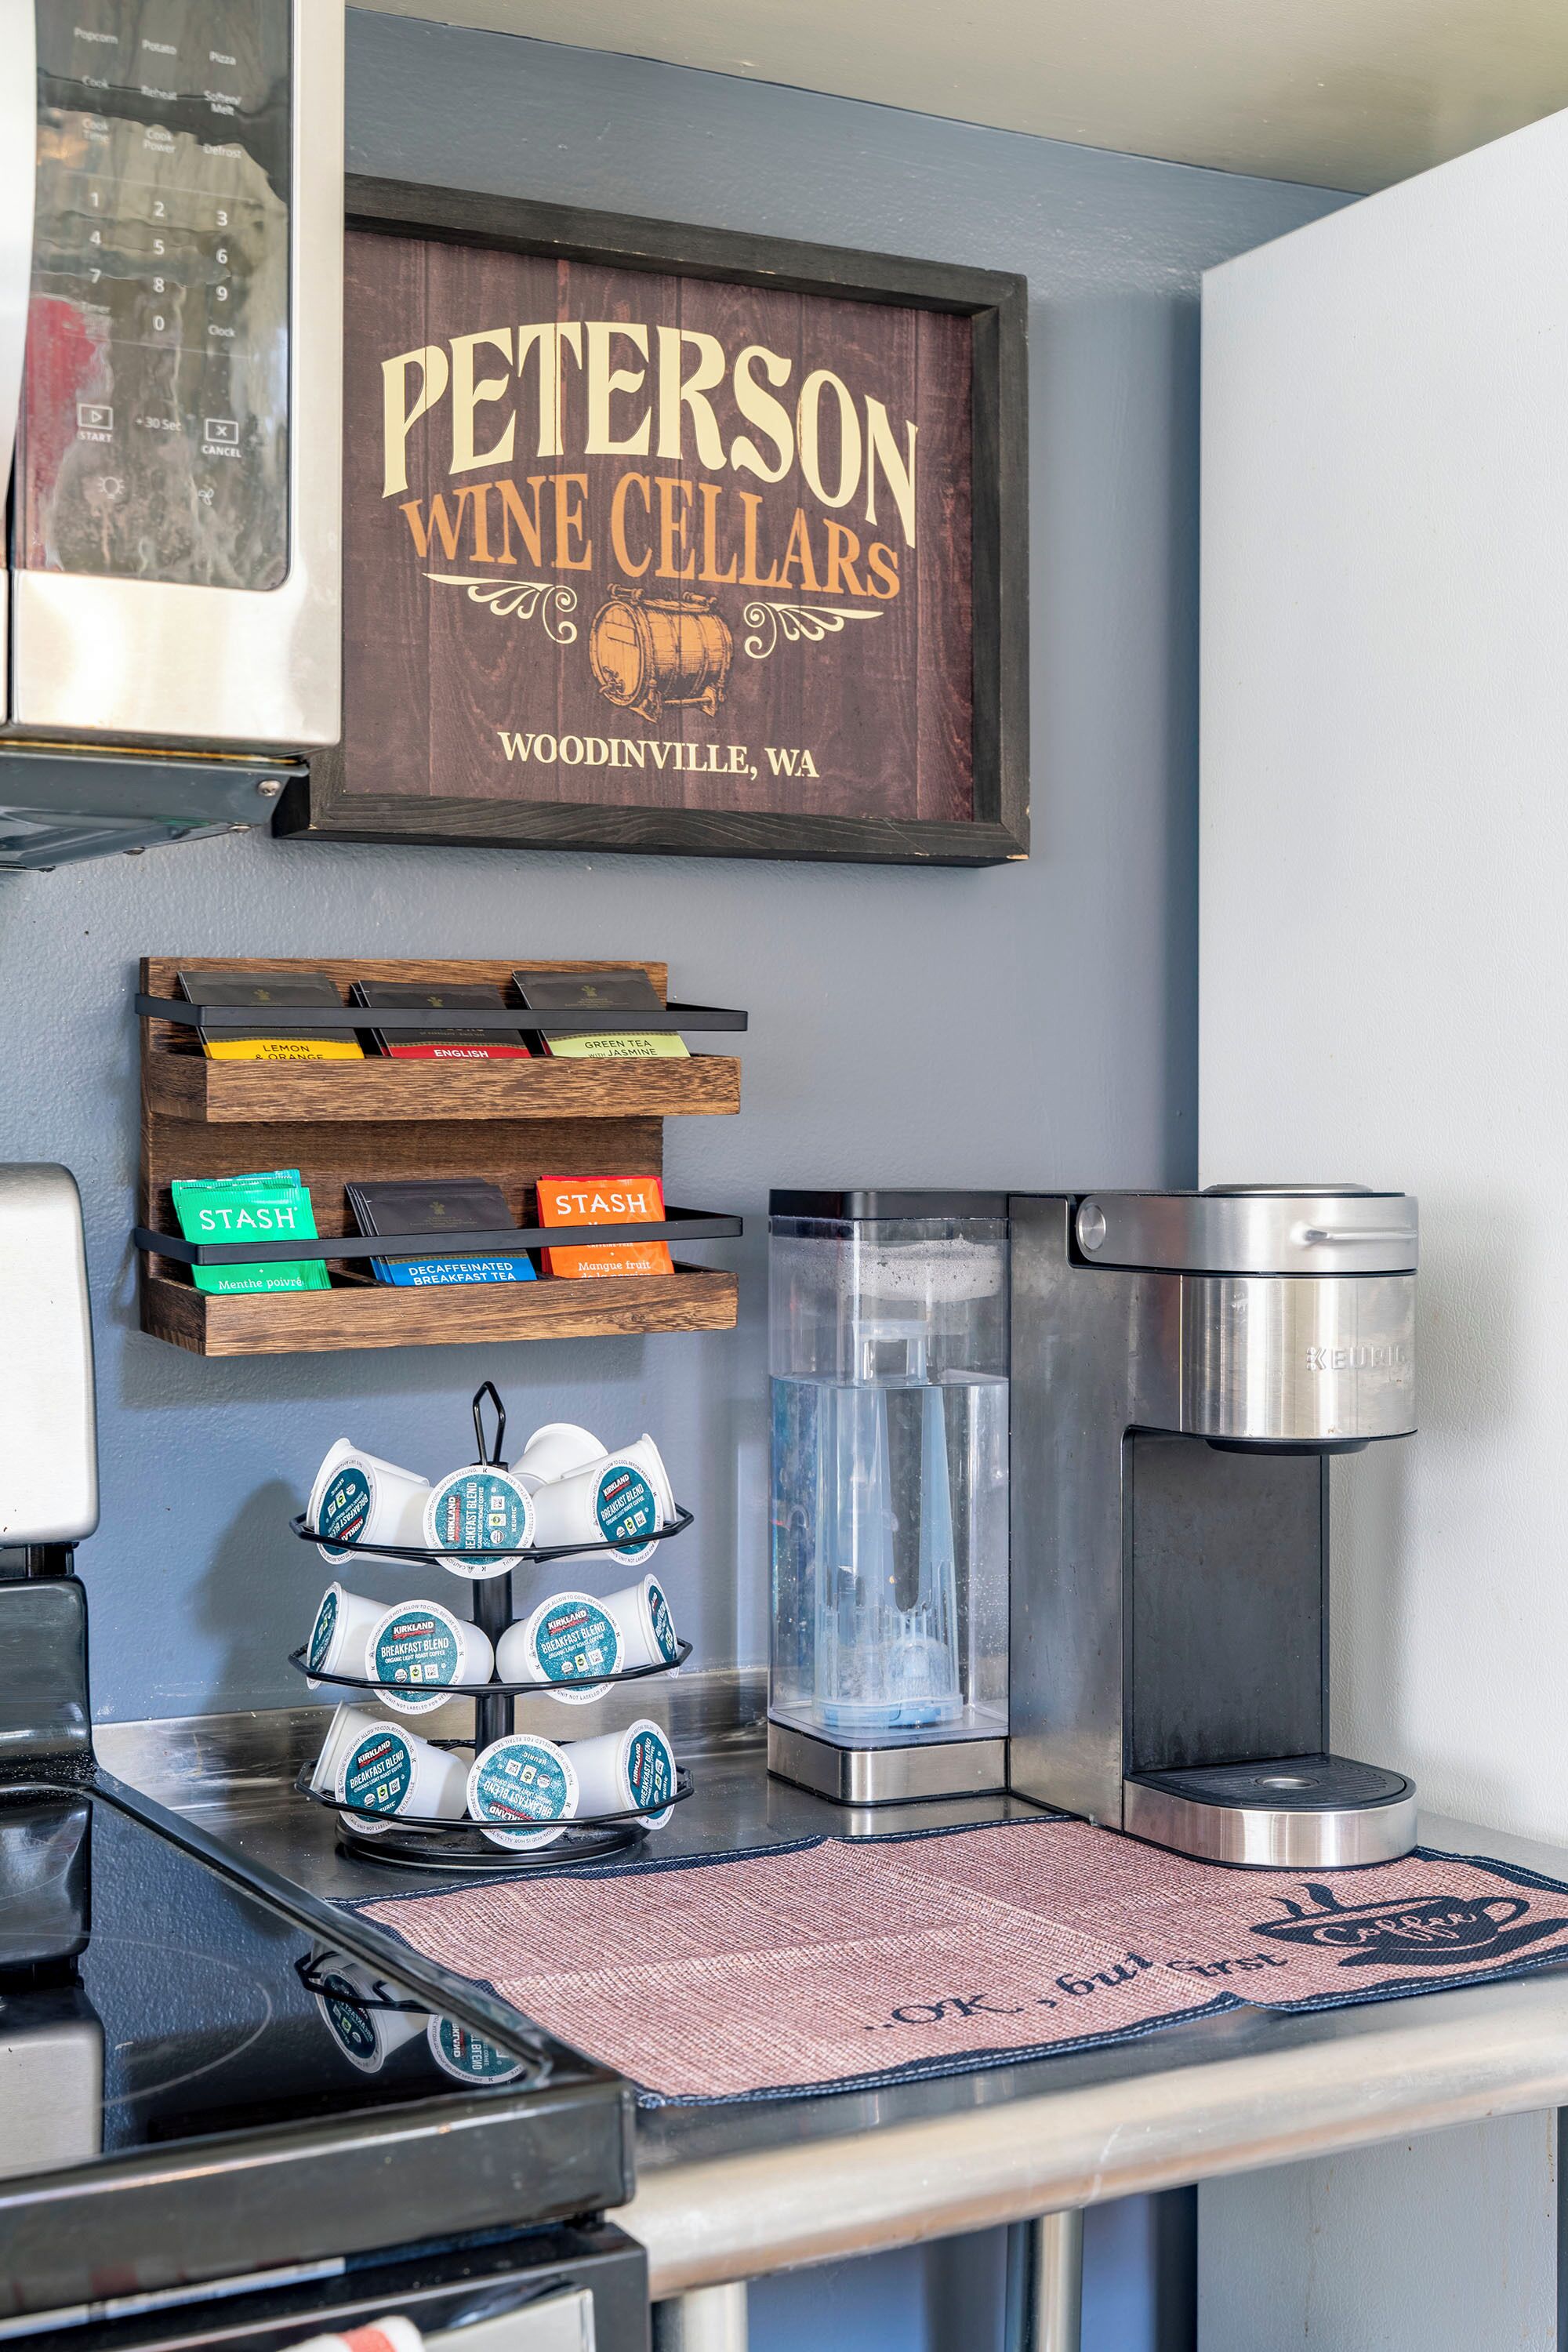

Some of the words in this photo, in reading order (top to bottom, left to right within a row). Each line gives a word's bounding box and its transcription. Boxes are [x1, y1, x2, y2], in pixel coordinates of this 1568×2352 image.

[143, 139, 176, 154] Power
[203, 143, 242, 159] Defrost
[92, 193, 100, 208] 1
[154, 201, 165, 217] 2
[216, 211, 228, 227] 3
[89, 231, 102, 245] 4
[154, 240, 165, 255] 5
[216, 249, 228, 264] 6
[89, 269, 101, 283] 7
[153, 278, 165, 293] 8
[216, 286, 228, 302] 9
[152, 315, 165, 332] 0
[208, 325, 236, 338] Clock
[79, 432, 114, 444] START
[382, 321, 918, 549] PETERSON
[201, 445, 242, 459] CANCEL
[399, 473, 592, 572] WINE
[611, 472, 900, 599] CELLARS
[498, 731, 758, 780] WOODINVILLE,
[766, 748, 819, 778] WA
[263, 1044, 310, 1053] LEMON
[585, 1040, 626, 1049] GREEN
[627, 1040, 652, 1048] TEA
[608, 1048, 658, 1057] JASMINE
[434, 1049, 489, 1058] ENGLISH
[556, 1193, 648, 1215] STASH
[408, 1262, 514, 1276] DECAFFEINATED
[578, 1262, 622, 1272] Mangue
[626, 1261, 652, 1269] fruit
[219, 1279, 263, 1290] Menthe
[413, 1272, 488, 1286] BREAKFAST
[491, 1272, 517, 1282] TEA
[1306, 1345, 1406, 1371] KEURIG
[602, 1474, 630, 1497] KIRKLAND
[466, 1483, 477, 1509] BLEND
[601, 1494, 627, 1521] BREAKFAST
[627, 1483, 644, 1502] BLEND
[447, 1497, 456, 1541] KIRKLAND
[466, 1510, 477, 1549] REAKFAST
[393, 1621, 434, 1634] KIRKLAND
[547, 1610, 587, 1630] KIRKLAND
[541, 1631, 581, 1654] BREAKFAST
[581, 1621, 605, 1638] BLEND
[381, 1641, 423, 1658] BREAKFAST
[423, 1637, 449, 1650] BLEND
[358, 1740, 391, 1763] KIRKLAND
[350, 1763, 384, 1788] BREAKFAST
[387, 1749, 405, 1768] BLEND
[633, 1743, 641, 1784] KIRKLAND
[483, 1780, 510, 1798] BLEND
[640, 1760, 652, 1806] BREAKFAST
[378, 1800, 396, 1812] EURIG
[510, 1789, 554, 1818] BREAKFAST
[1312, 1912, 1478, 1945] Coffee
